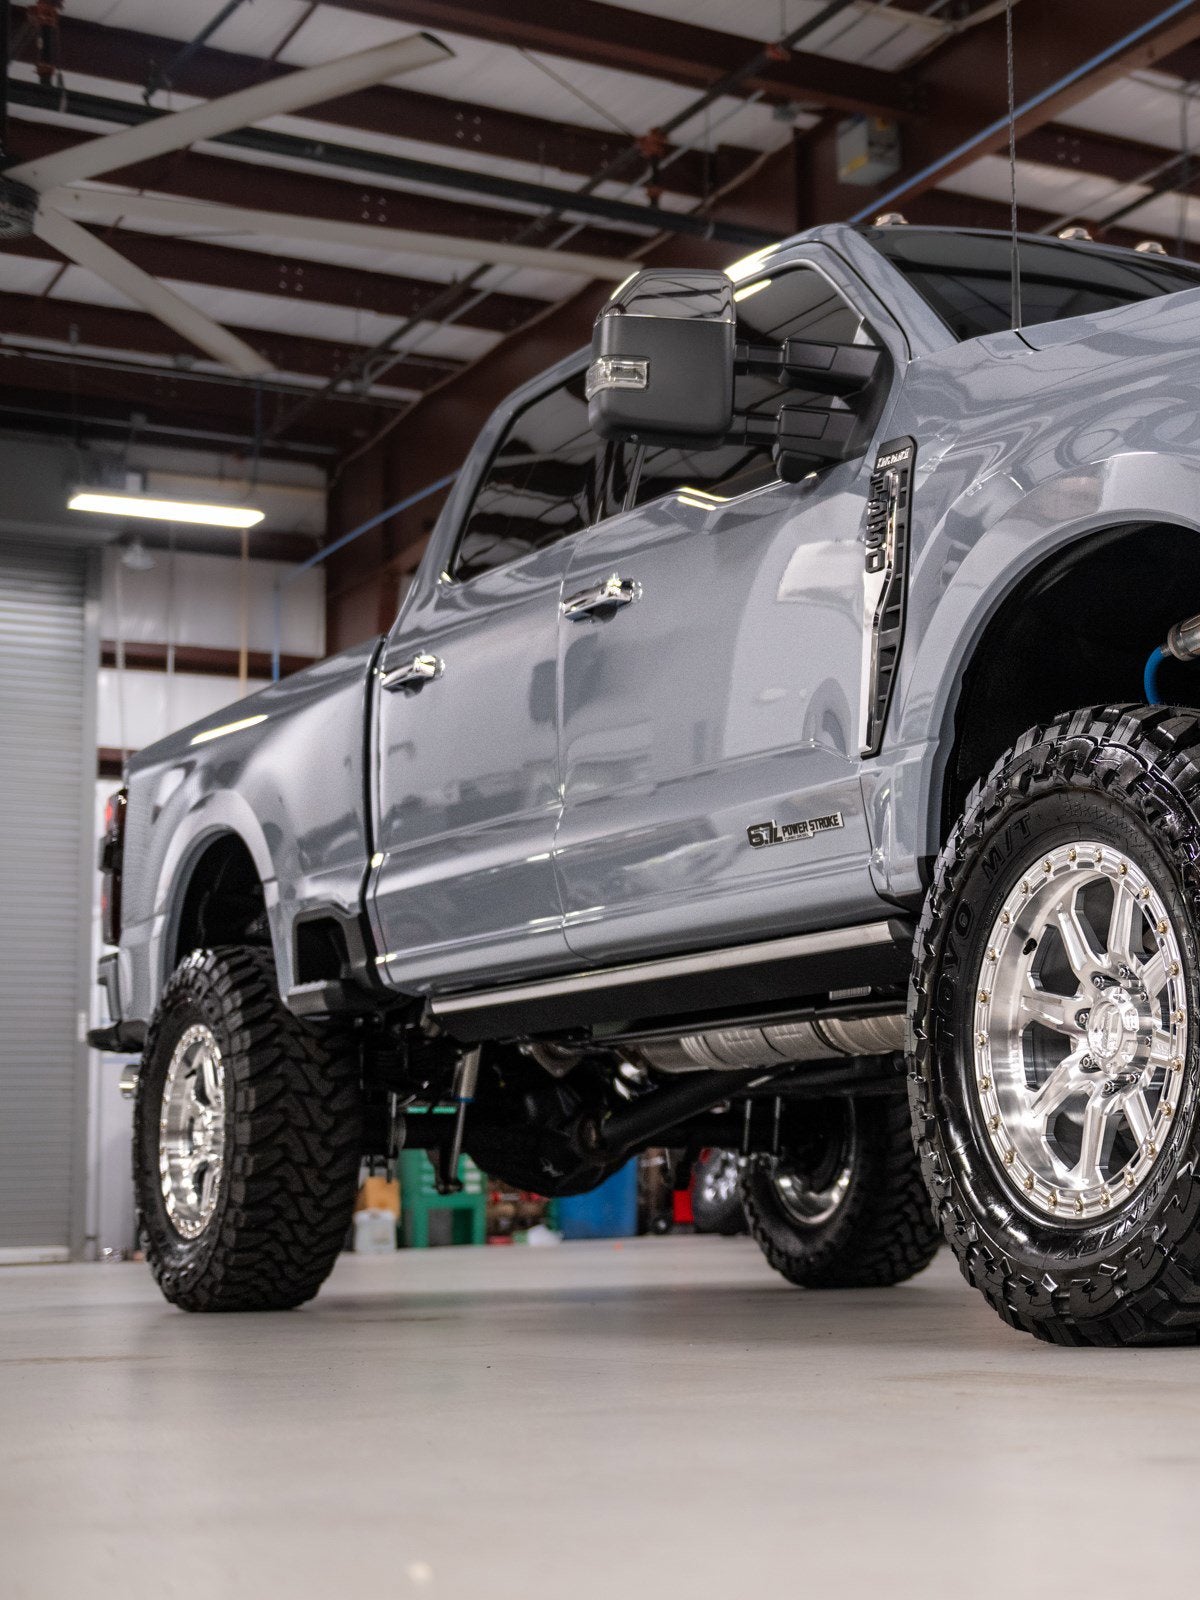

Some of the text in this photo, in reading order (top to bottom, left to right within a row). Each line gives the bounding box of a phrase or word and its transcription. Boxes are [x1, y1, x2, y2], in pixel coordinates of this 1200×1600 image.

[747, 821, 783, 847] 6.7L
[781, 820, 809, 837] POWER
[808, 814, 840, 831] STROKE
